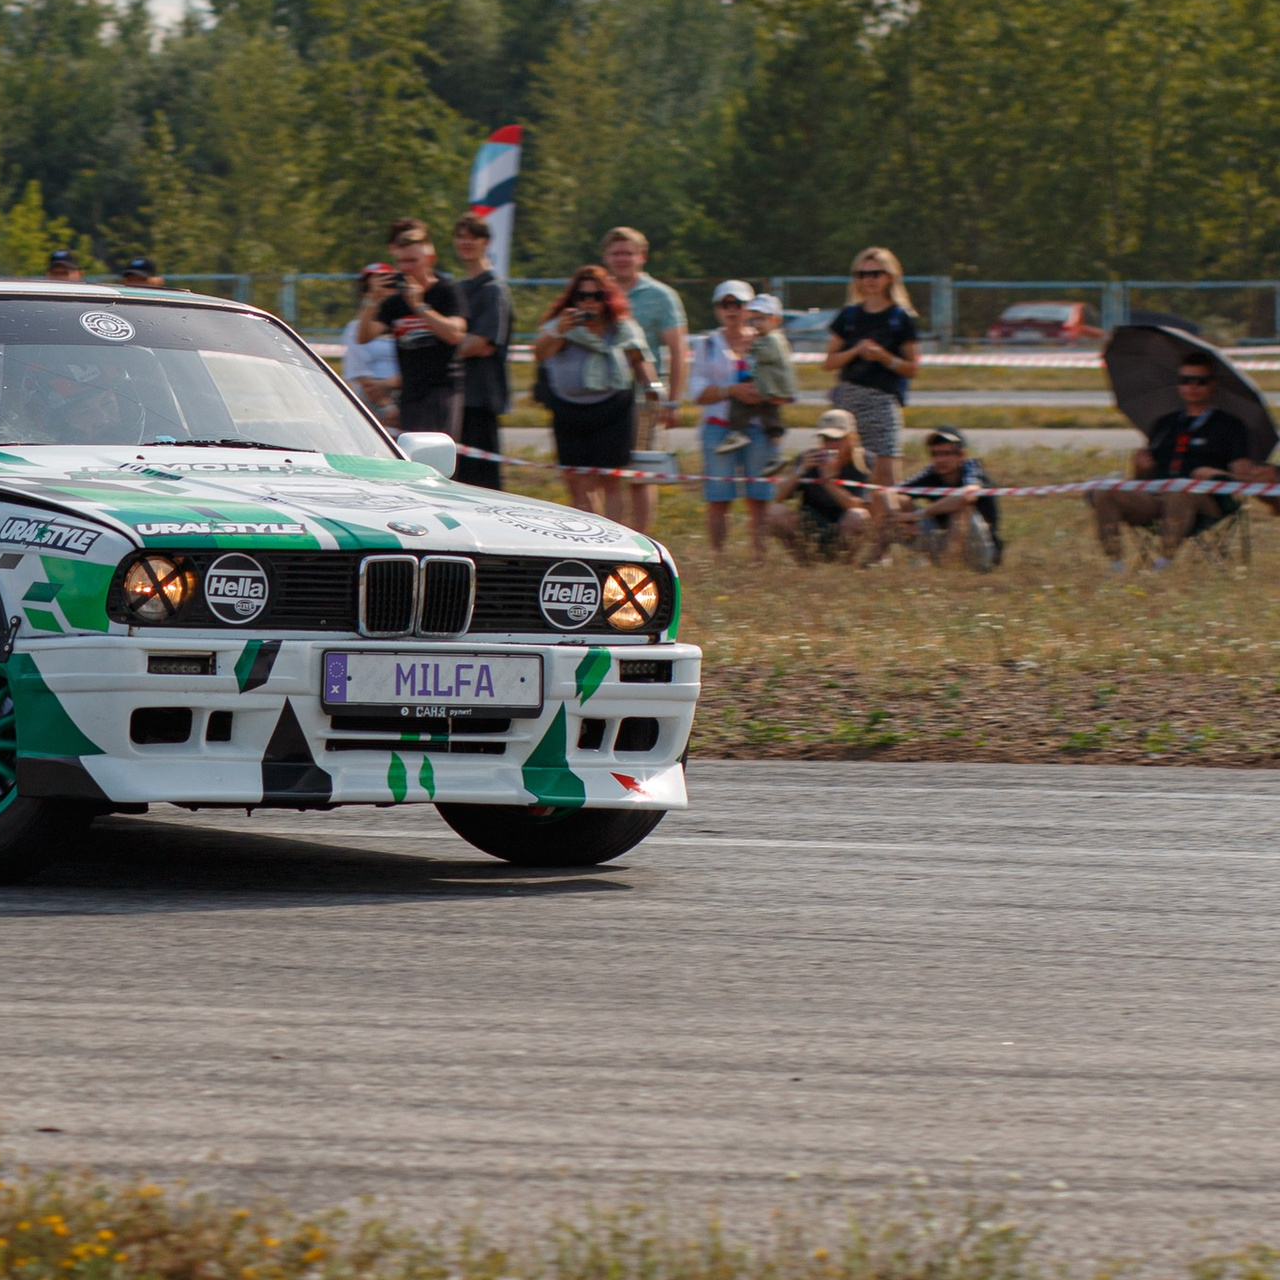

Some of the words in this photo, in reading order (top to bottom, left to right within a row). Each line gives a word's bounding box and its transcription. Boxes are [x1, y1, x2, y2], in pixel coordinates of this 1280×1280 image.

[209, 577, 263, 597] Hella
[543, 583, 596, 603] Hella
[395, 663, 495, 697] MILFA
[416, 706, 446, 717] САНЯ
